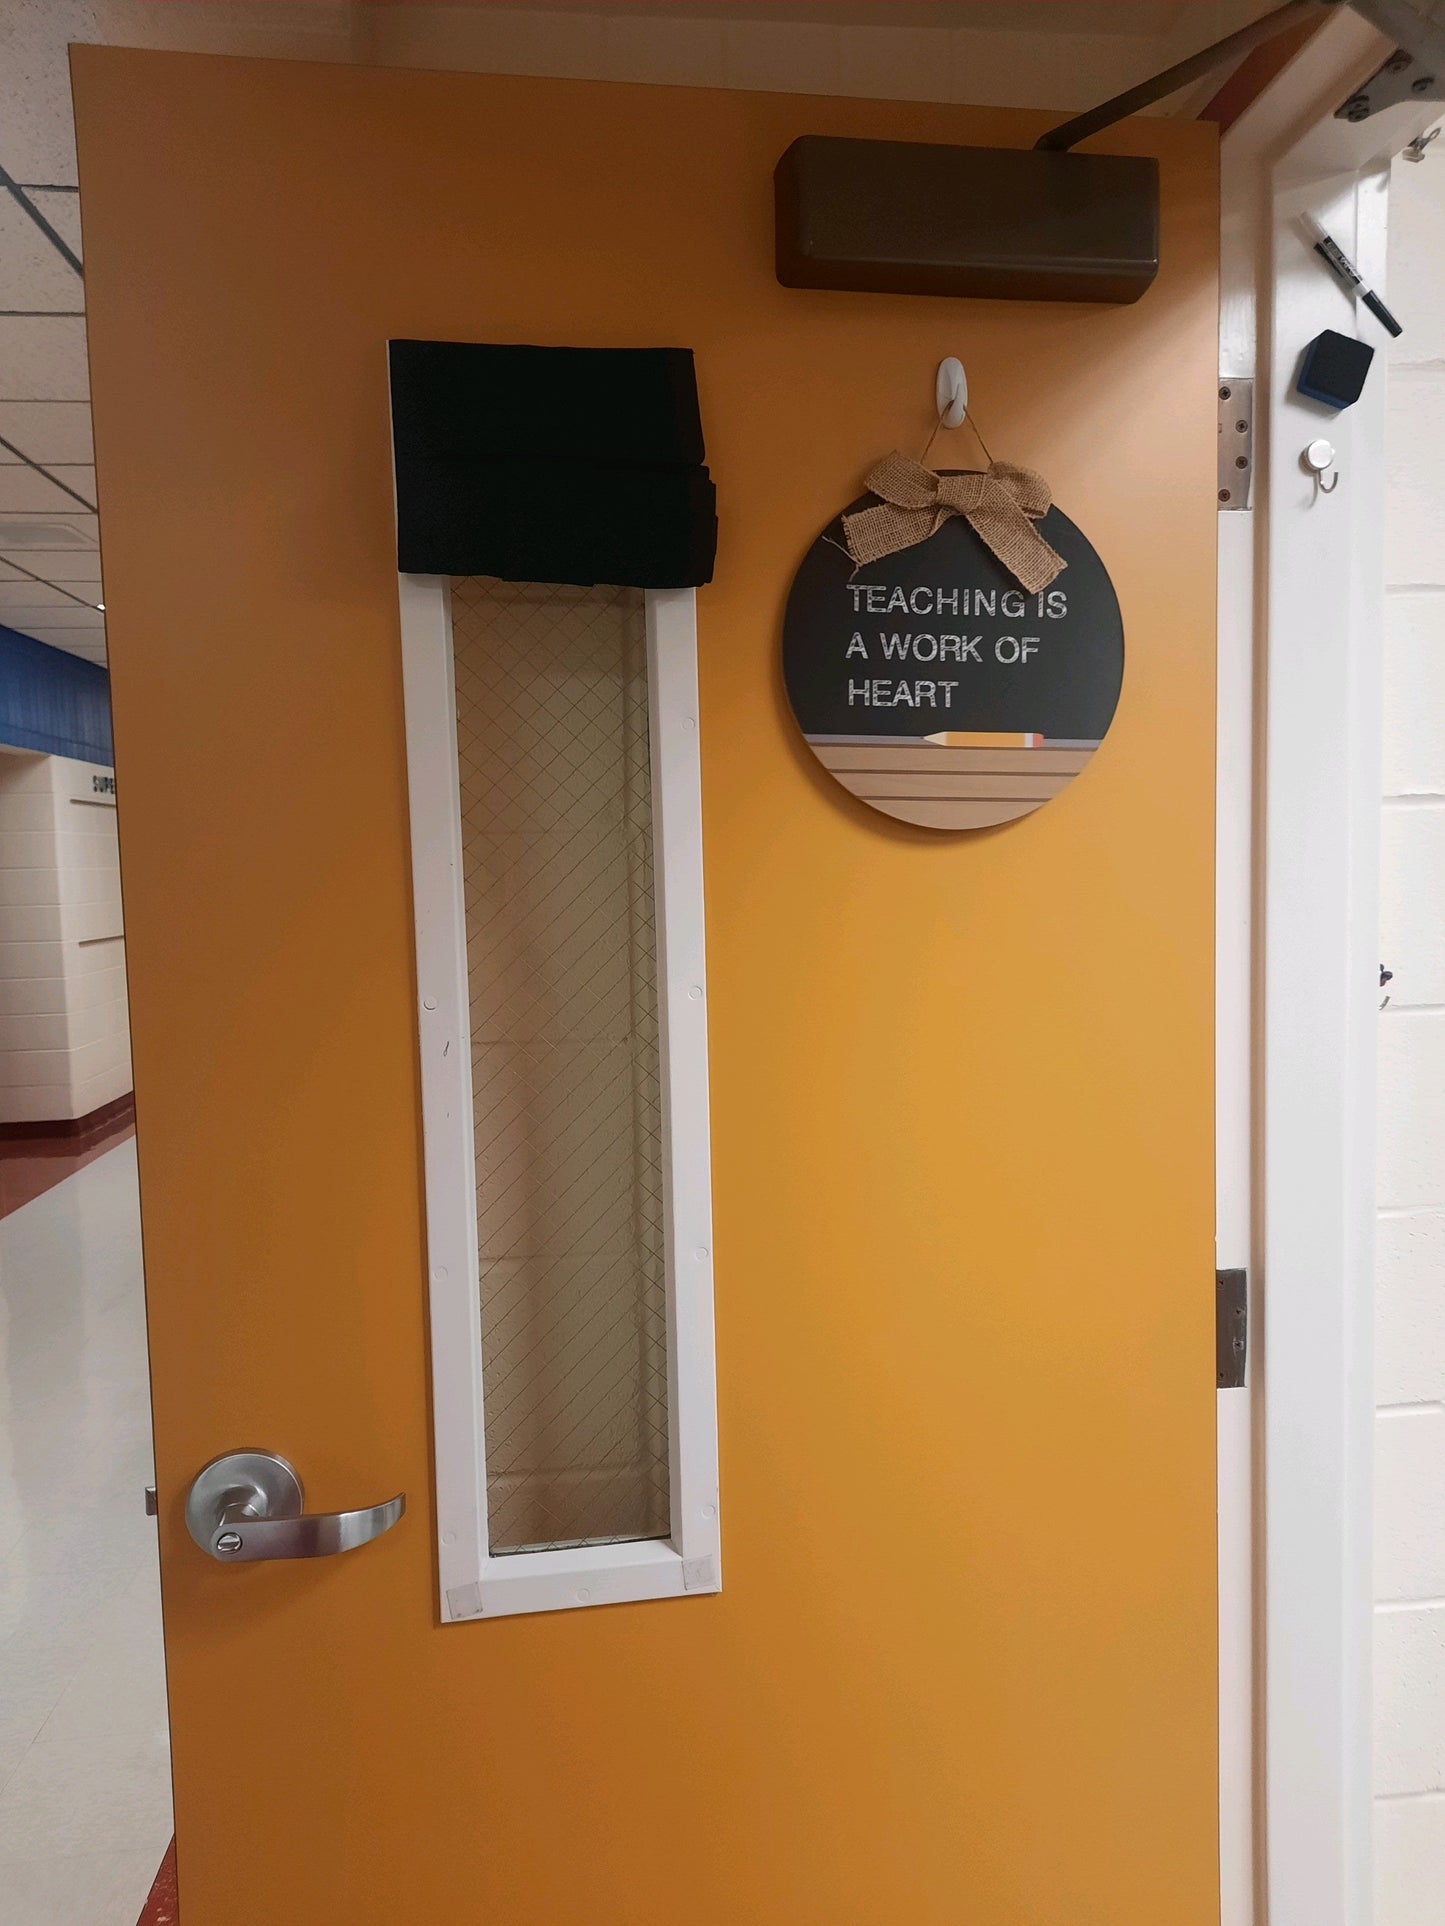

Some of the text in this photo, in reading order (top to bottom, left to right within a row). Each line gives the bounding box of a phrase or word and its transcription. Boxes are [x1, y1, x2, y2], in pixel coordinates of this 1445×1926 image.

[846, 584, 1068, 619] TEACHING IS
[845, 631, 1041, 664] A WORK OF
[848, 678, 959, 708] HEART
